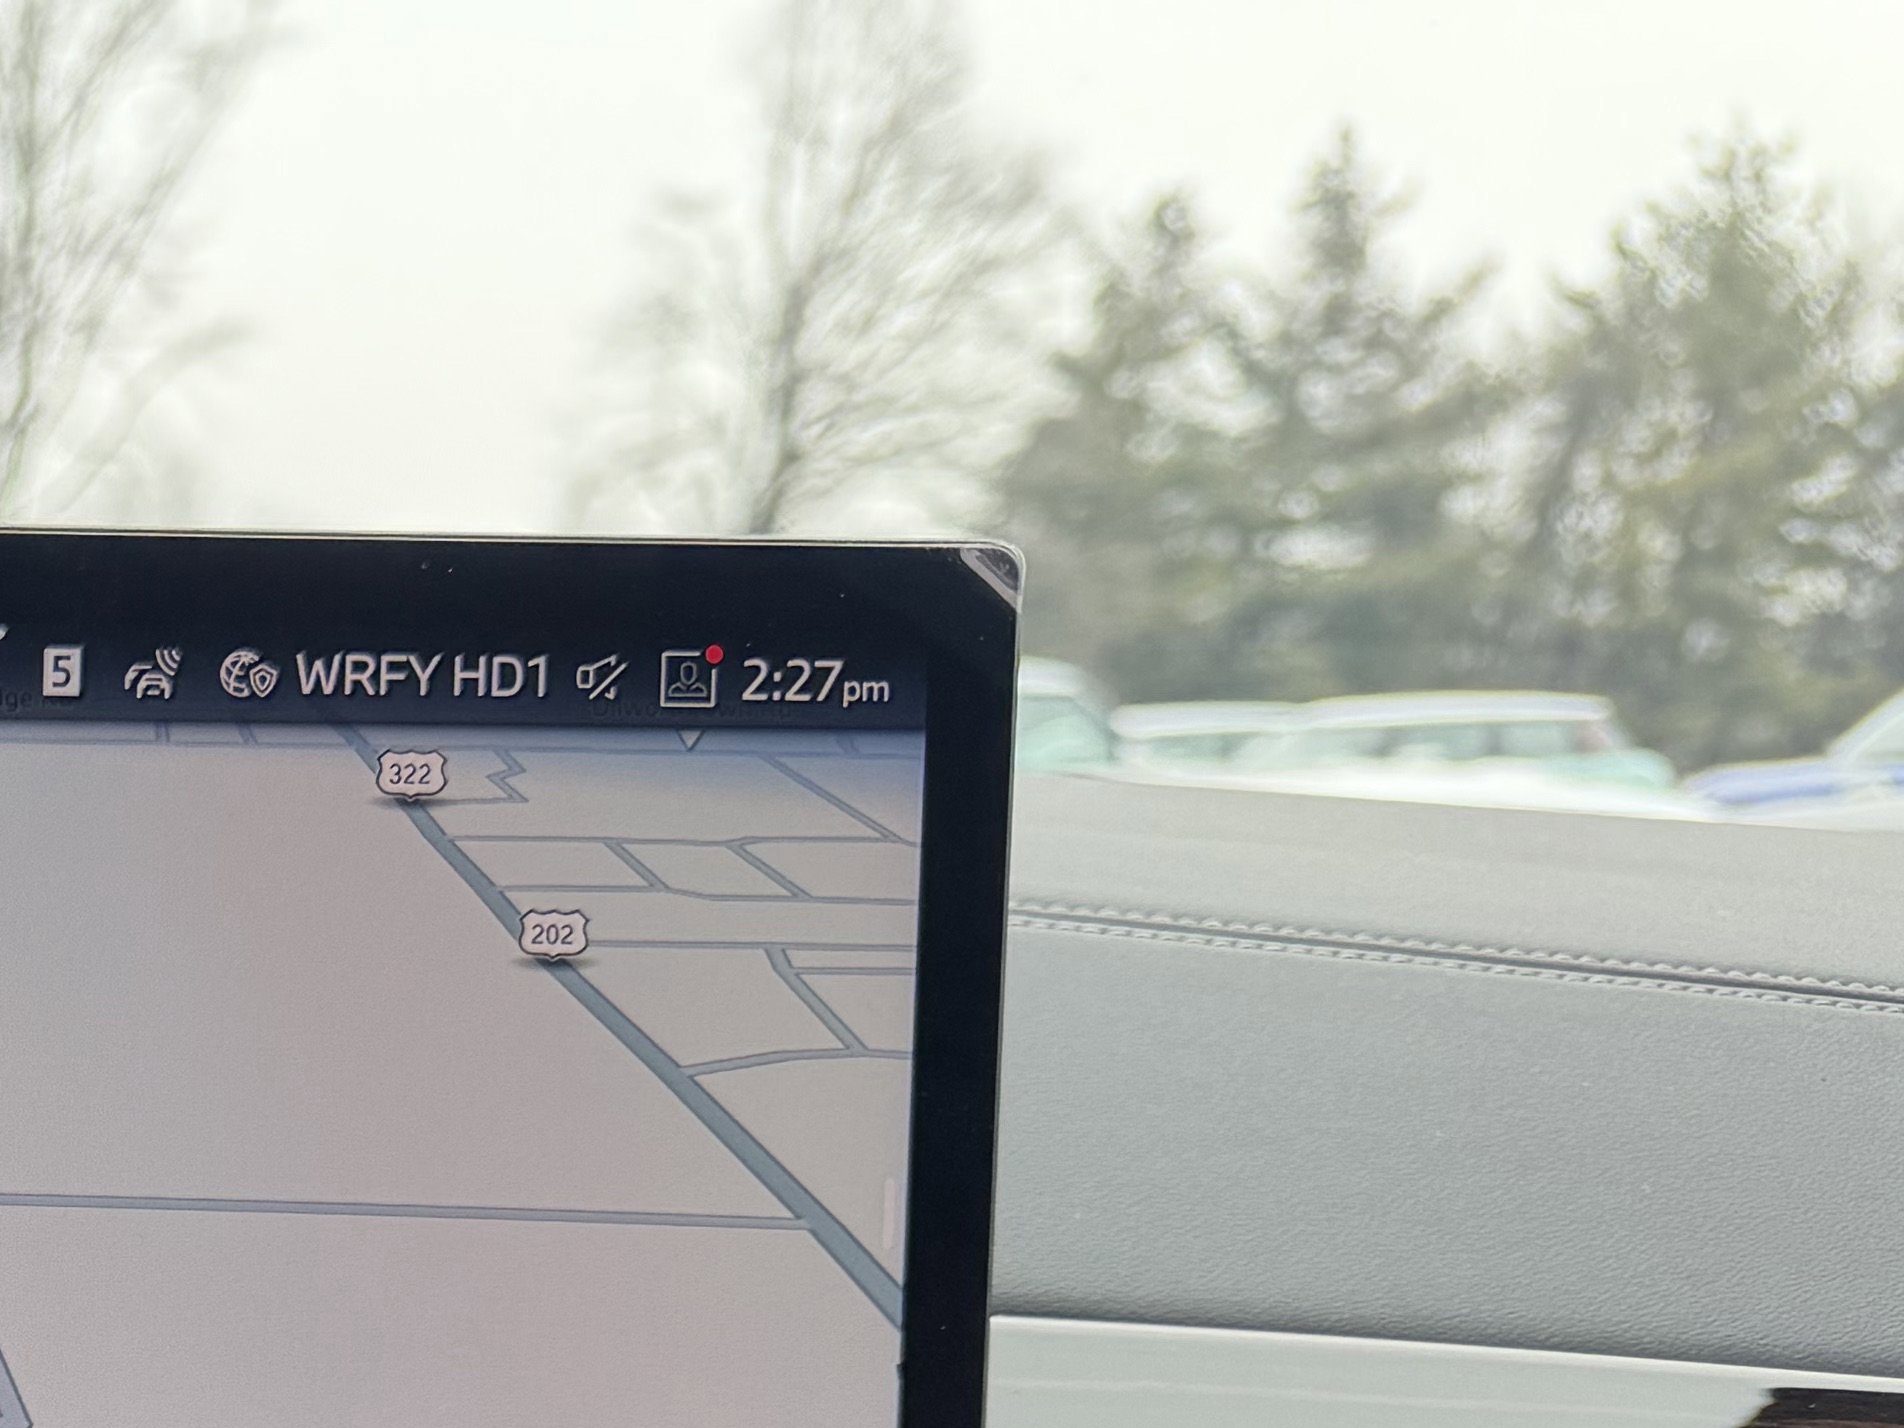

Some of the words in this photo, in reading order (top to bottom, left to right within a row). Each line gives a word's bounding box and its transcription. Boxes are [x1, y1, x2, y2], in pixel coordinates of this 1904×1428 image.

[295, 653, 442, 696] WRFY
[453, 654, 548, 698] HD1
[388, 763, 432, 785] 322
[530, 924, 574, 946] 202
